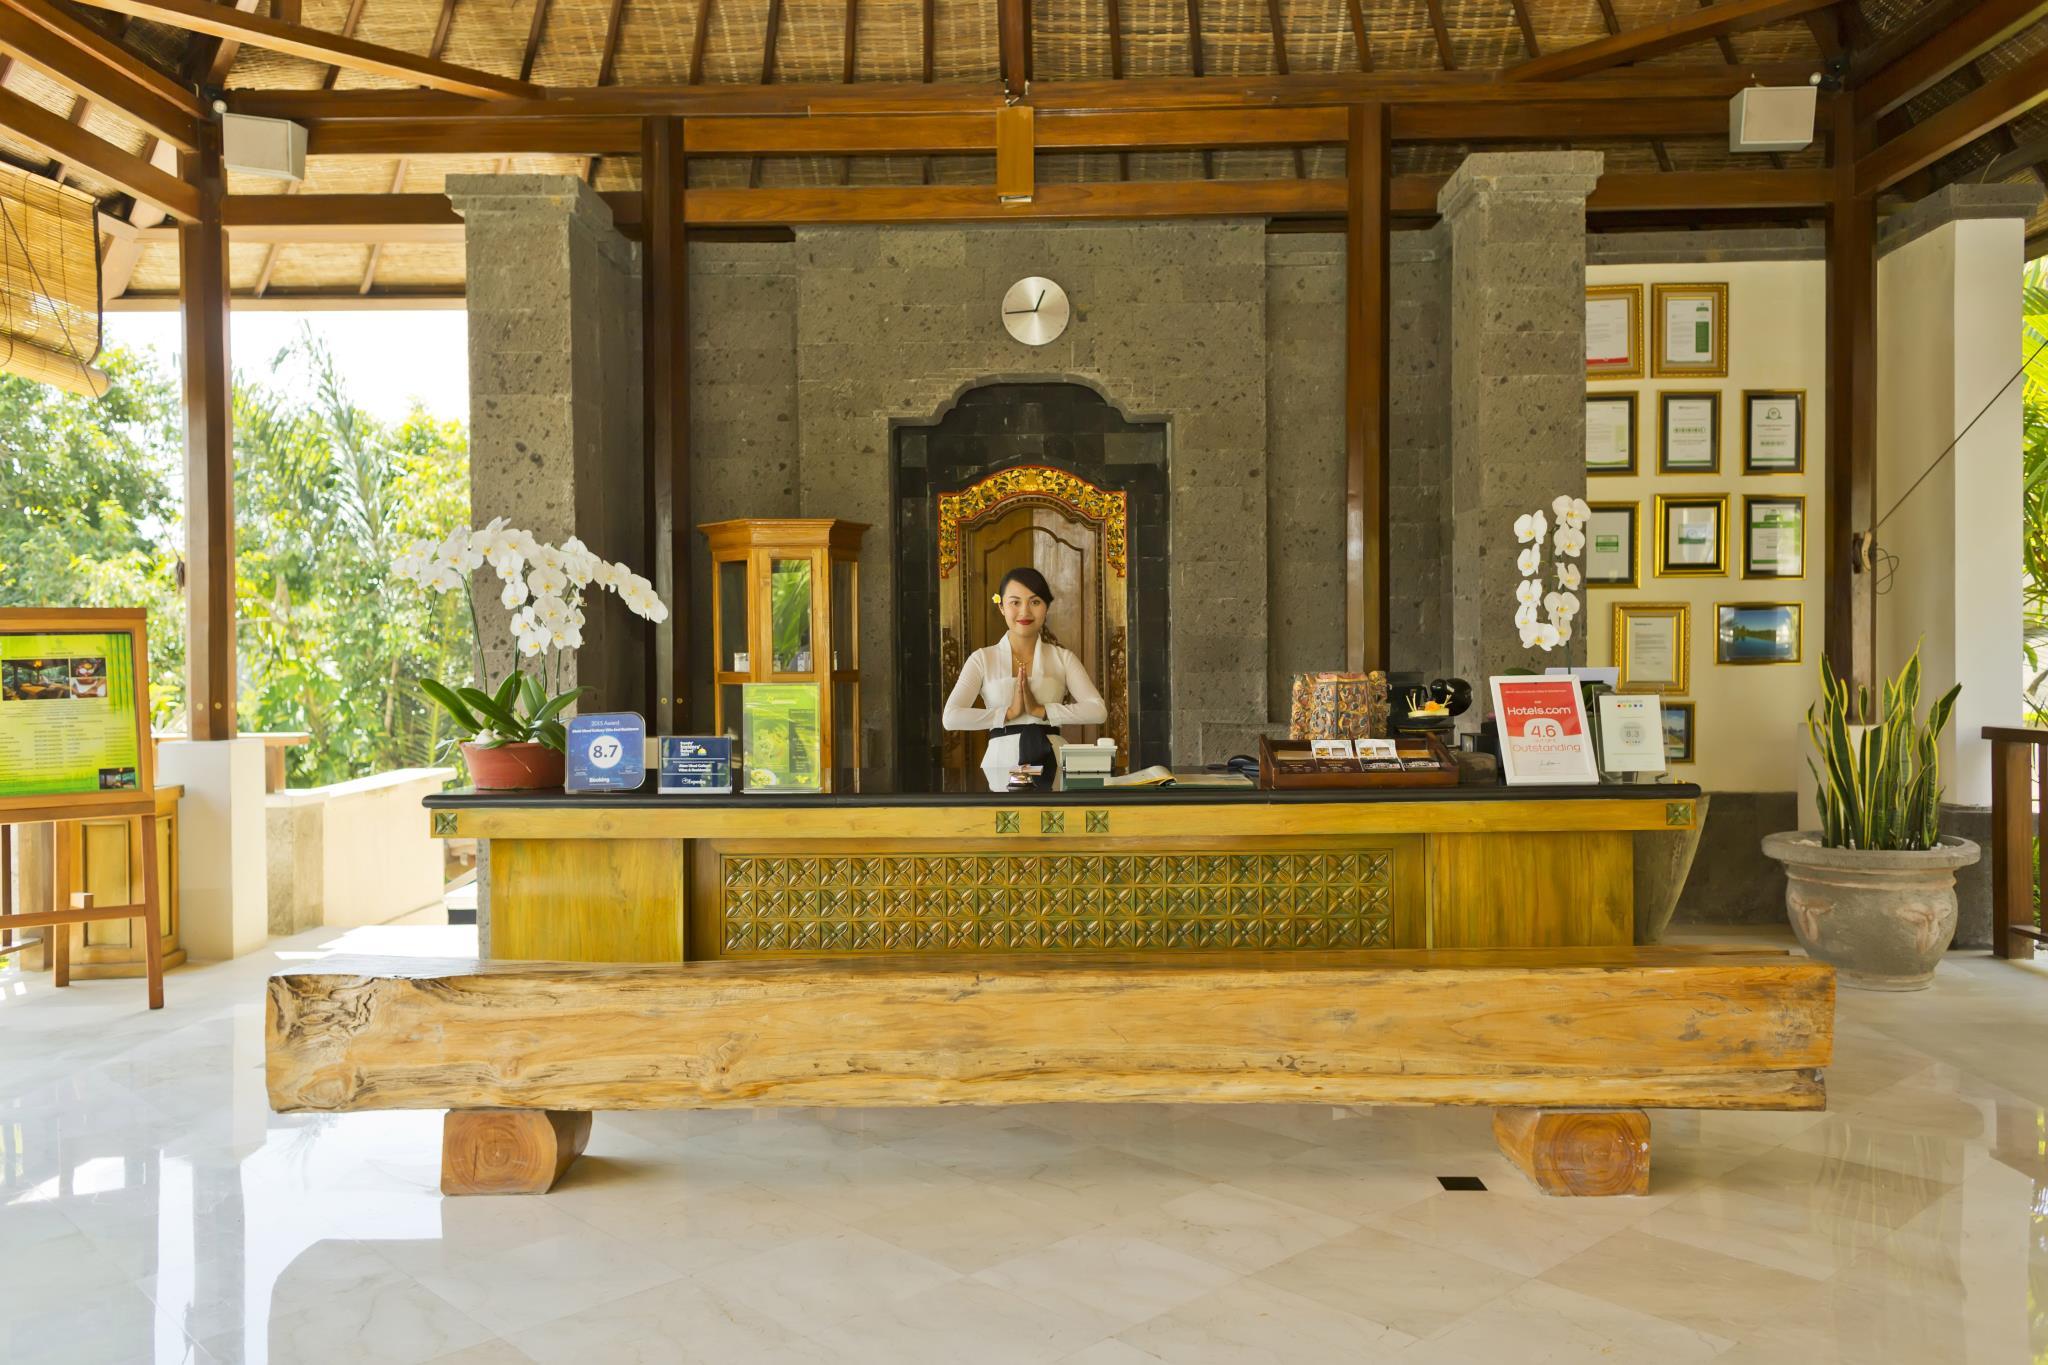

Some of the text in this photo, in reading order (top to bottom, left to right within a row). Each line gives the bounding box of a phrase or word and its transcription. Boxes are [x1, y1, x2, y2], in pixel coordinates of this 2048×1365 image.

[1507, 706, 1571, 716] Hotels.com
[1531, 725, 1557, 738] 4.6
[593, 744, 618, 758] 8.7
[1512, 743, 1581, 753] Outstanding
